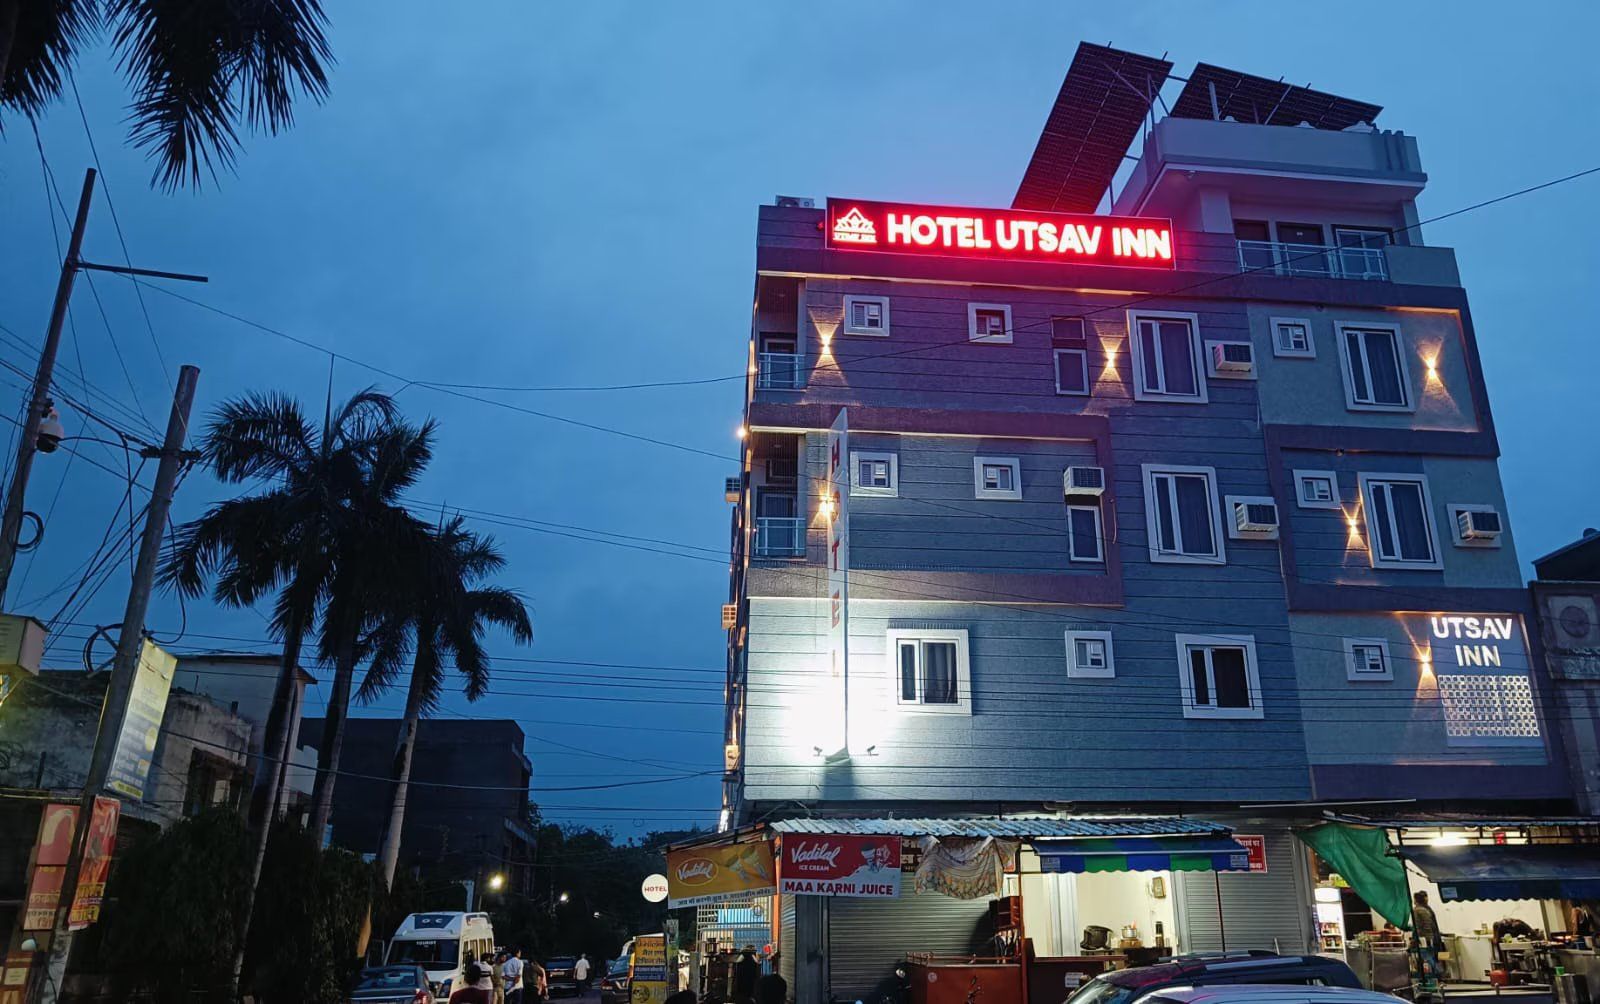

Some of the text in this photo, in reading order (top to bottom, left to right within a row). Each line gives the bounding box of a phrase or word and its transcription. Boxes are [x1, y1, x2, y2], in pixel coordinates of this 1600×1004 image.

[887, 212, 1172, 259] HOTEL UTSAV INN
[1431, 616, 1513, 640] UTSAV
[1455, 645, 1501, 667] INN
[791, 841, 841, 867] Vadilal
[678, 862, 714, 880] Vadilal
[644, 885, 667, 893] HOTEL
[785, 881, 893, 895] MAA KARNI JUICE
